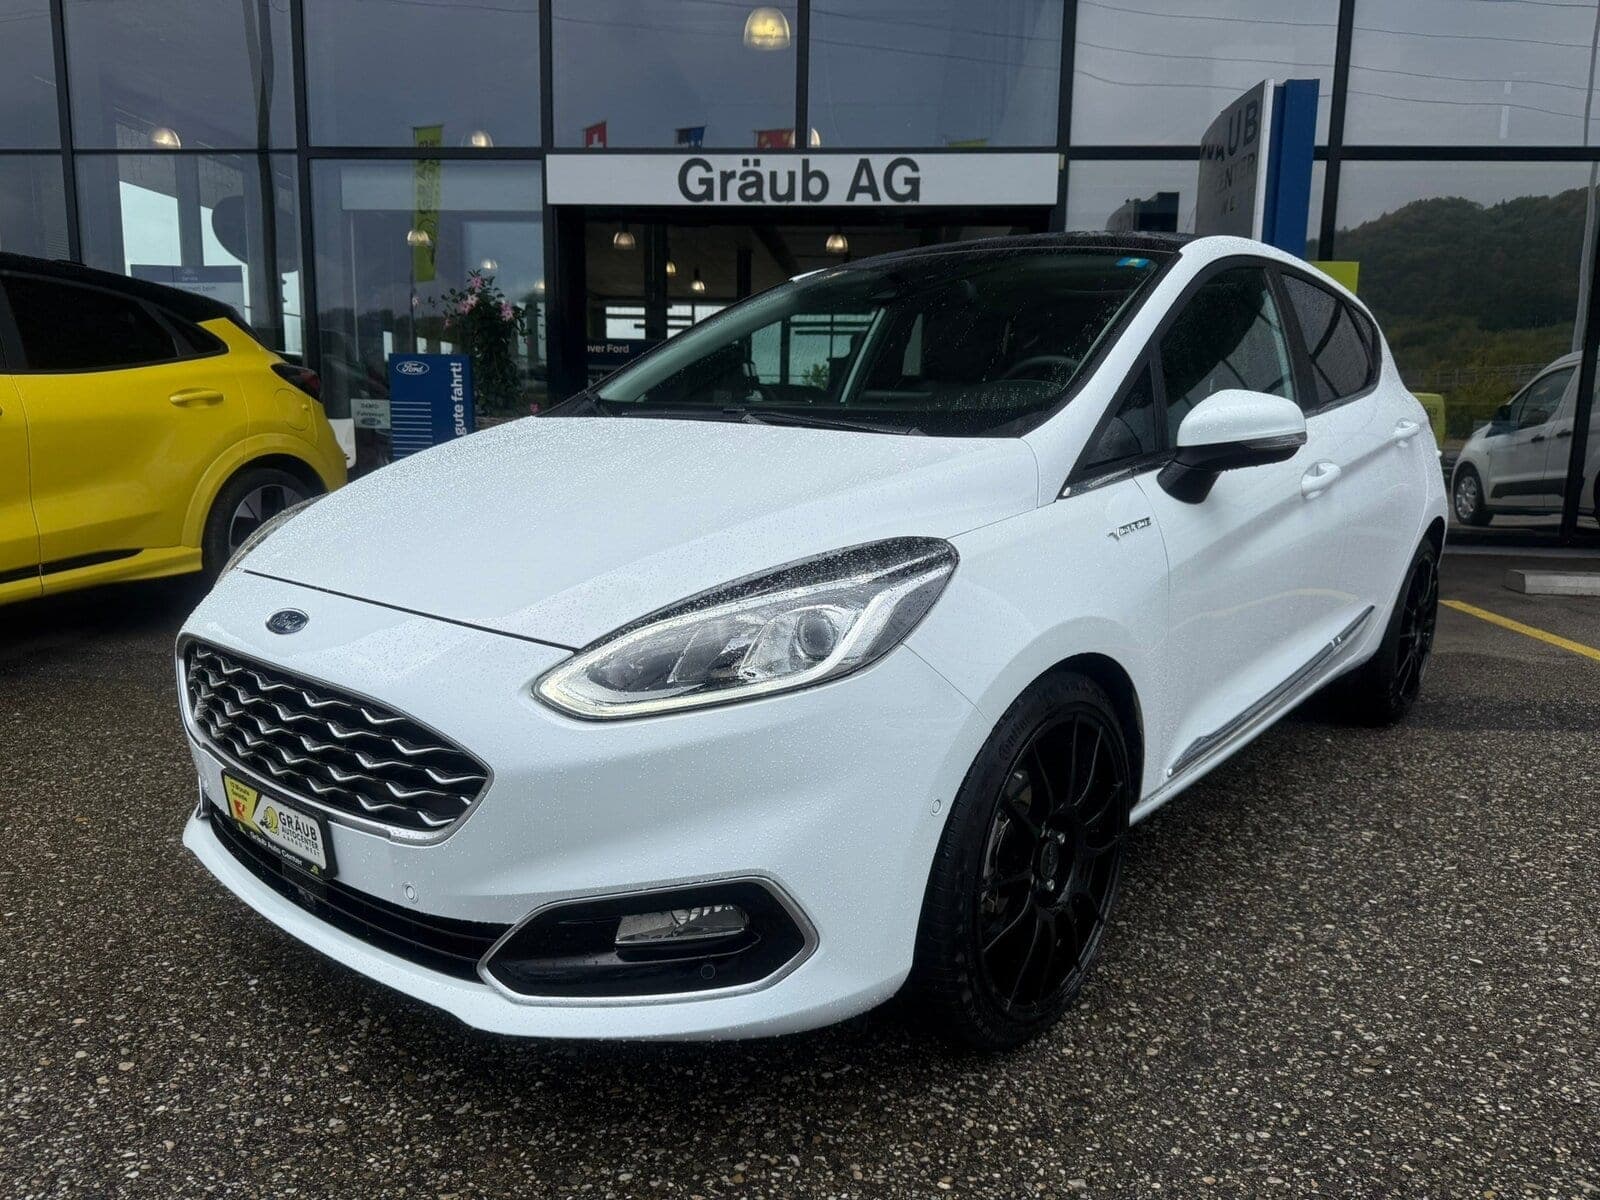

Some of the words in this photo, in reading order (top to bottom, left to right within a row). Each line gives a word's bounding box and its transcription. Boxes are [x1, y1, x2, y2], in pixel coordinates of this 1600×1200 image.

[678, 157, 829, 203] Gräub
[845, 157, 921, 203] AG
[606, 344, 630, 353] Ford
[450, 362, 464, 402] fahrt!
[453, 404, 467, 436] gute
[279, 811, 317, 841] GRÄUB
